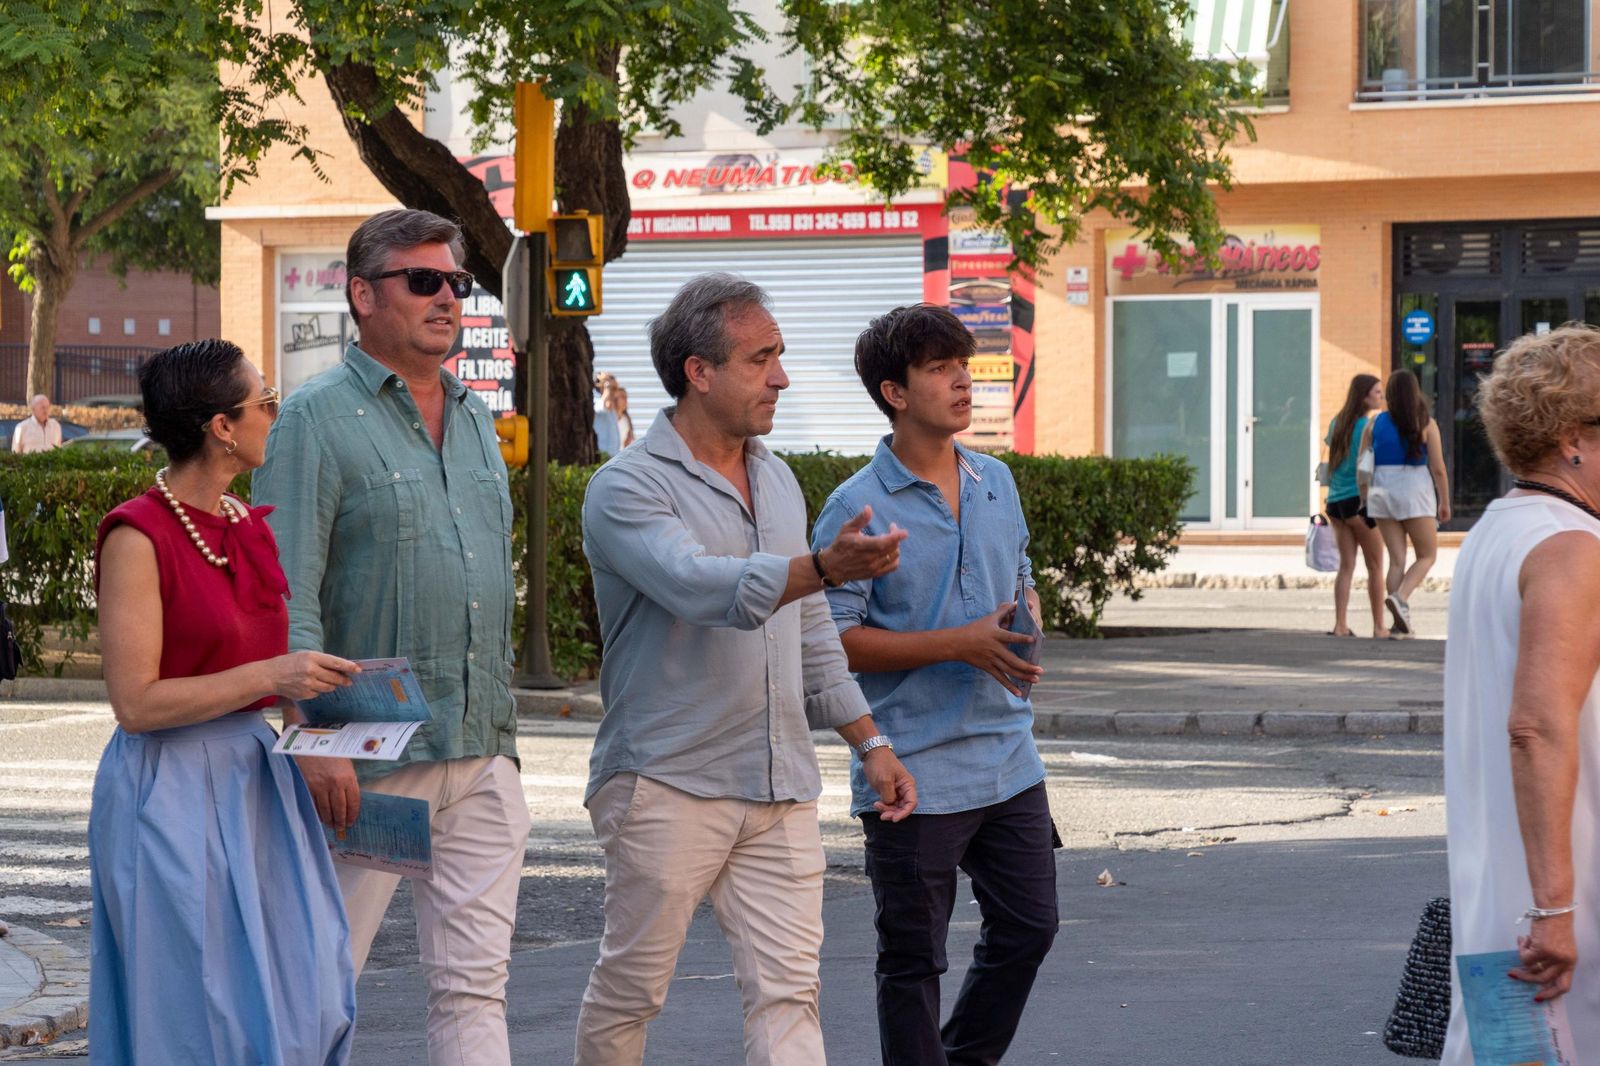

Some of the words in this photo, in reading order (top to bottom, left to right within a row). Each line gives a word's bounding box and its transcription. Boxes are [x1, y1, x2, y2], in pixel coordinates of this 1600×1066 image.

[632, 169, 656, 189] Q
[662, 158, 864, 189] NEUMÁTICO
[1178, 241, 1321, 273] MÁTICOS
[461, 327, 509, 349] ACEITE
[457, 358, 514, 381] FILTROS
[475, 385, 514, 411] ERÍA
